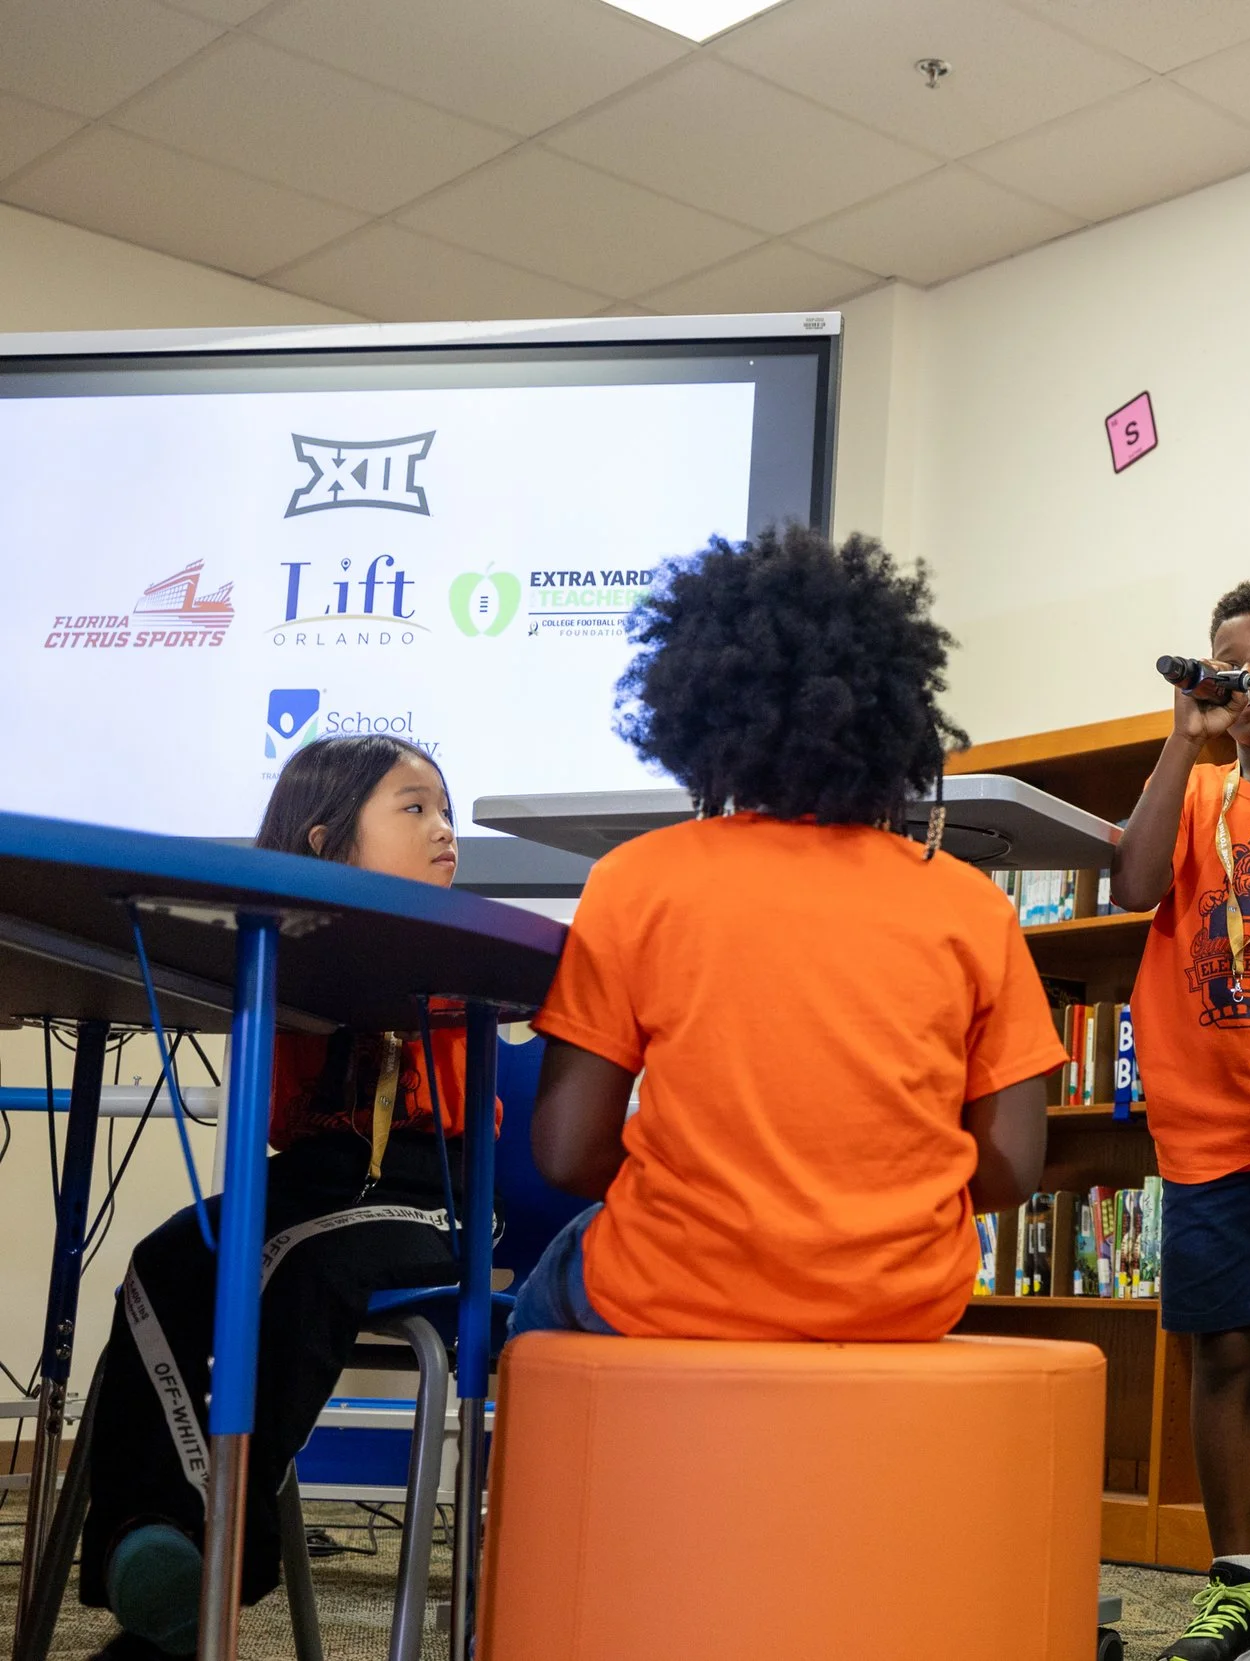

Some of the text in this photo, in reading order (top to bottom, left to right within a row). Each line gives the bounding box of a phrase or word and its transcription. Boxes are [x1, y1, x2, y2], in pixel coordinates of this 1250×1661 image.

[1125, 421, 1140, 446] S
[281, 554, 416, 621] Lift
[530, 570, 654, 587] EXTRA YARD
[53, 615, 129, 629] FLORIDA
[542, 619, 575, 627] COLLEGE
[44, 630, 226, 648] CITRUS SPORTS
[273, 632, 414, 646] ORLANDO
[325, 711, 413, 733] School
[1119, 1021, 1133, 1052] B
[1117, 1057, 1131, 1089] B
[154, 1363, 206, 1472] OFF-WHITE
